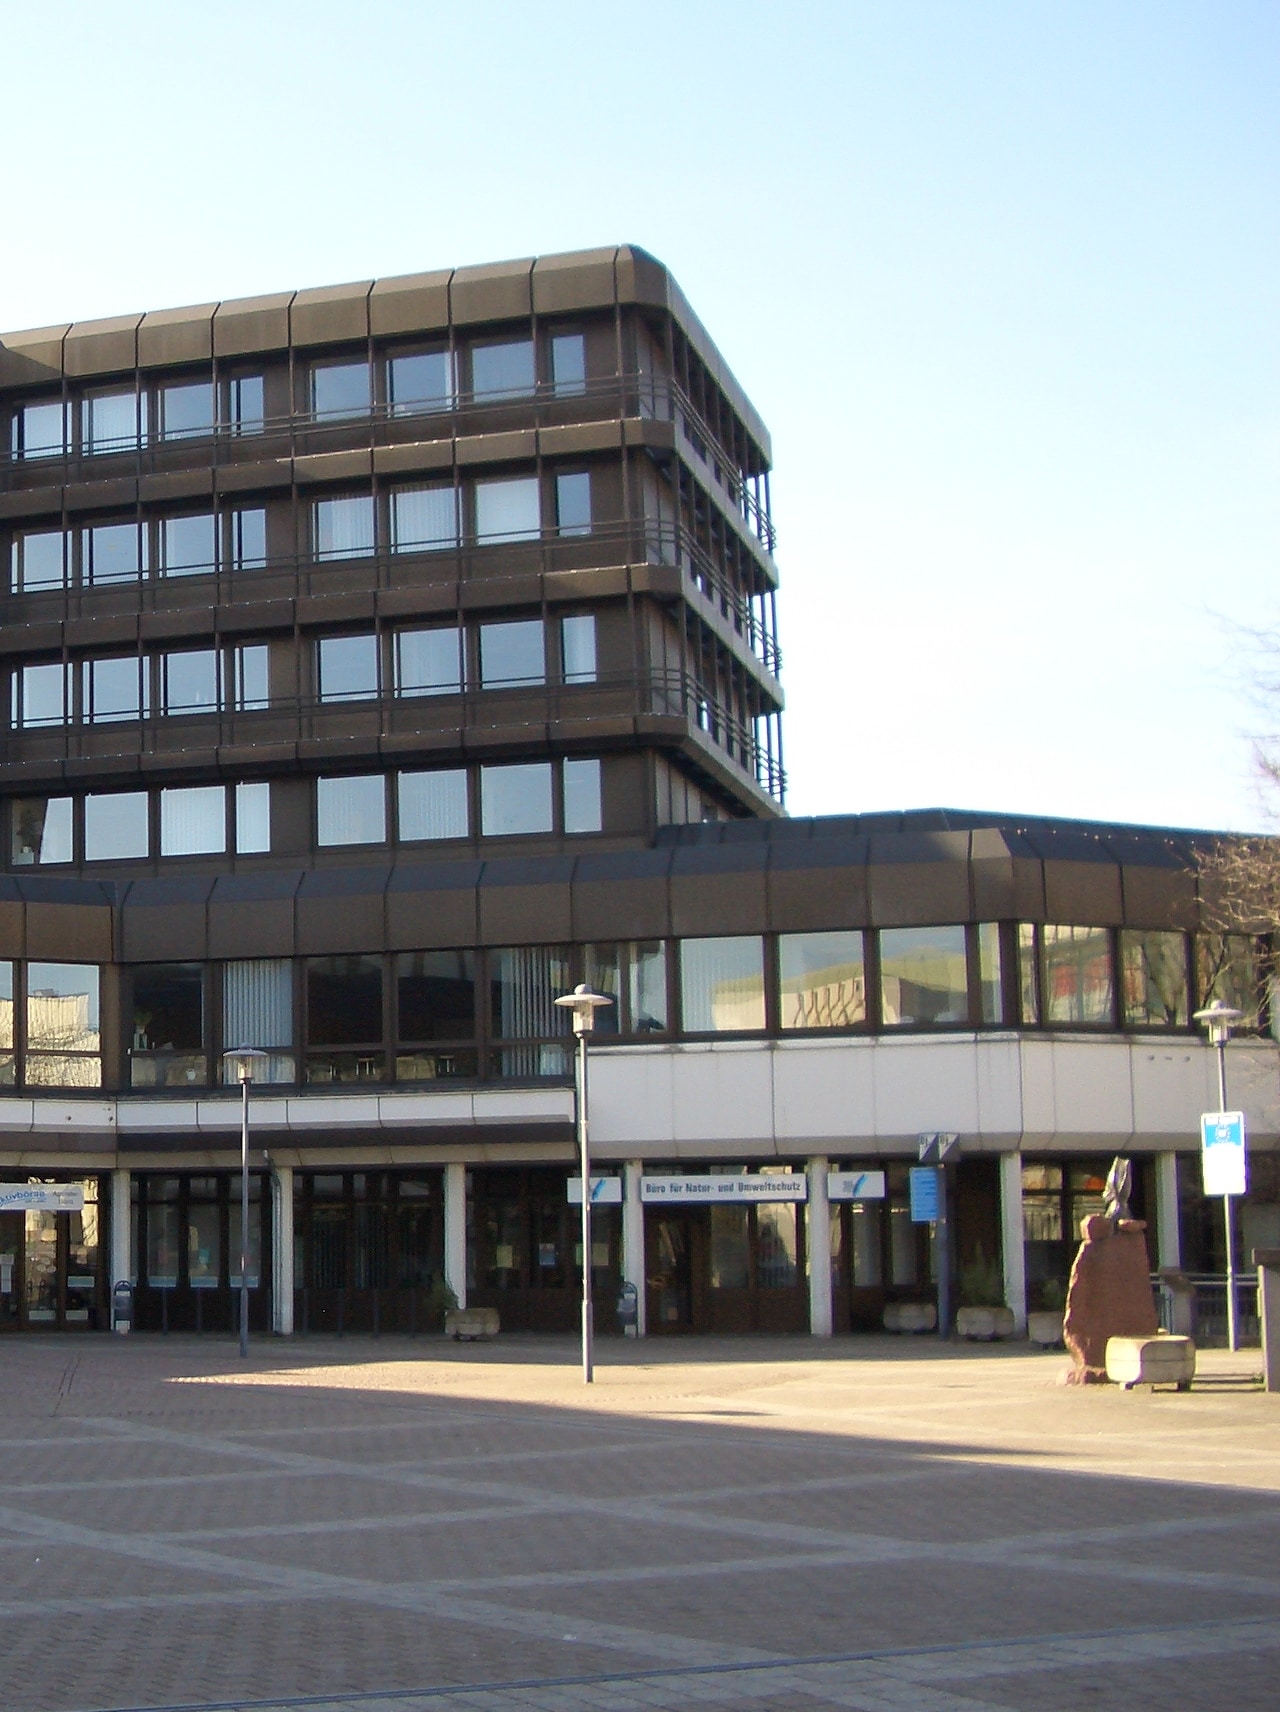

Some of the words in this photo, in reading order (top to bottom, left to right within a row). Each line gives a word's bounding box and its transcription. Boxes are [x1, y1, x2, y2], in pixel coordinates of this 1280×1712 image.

[645, 1183, 666, 1193] Büro
[670, 1183, 683, 1193] für
[717, 1183, 735, 1193] und
[737, 1181, 801, 1193] Umweltschutz
